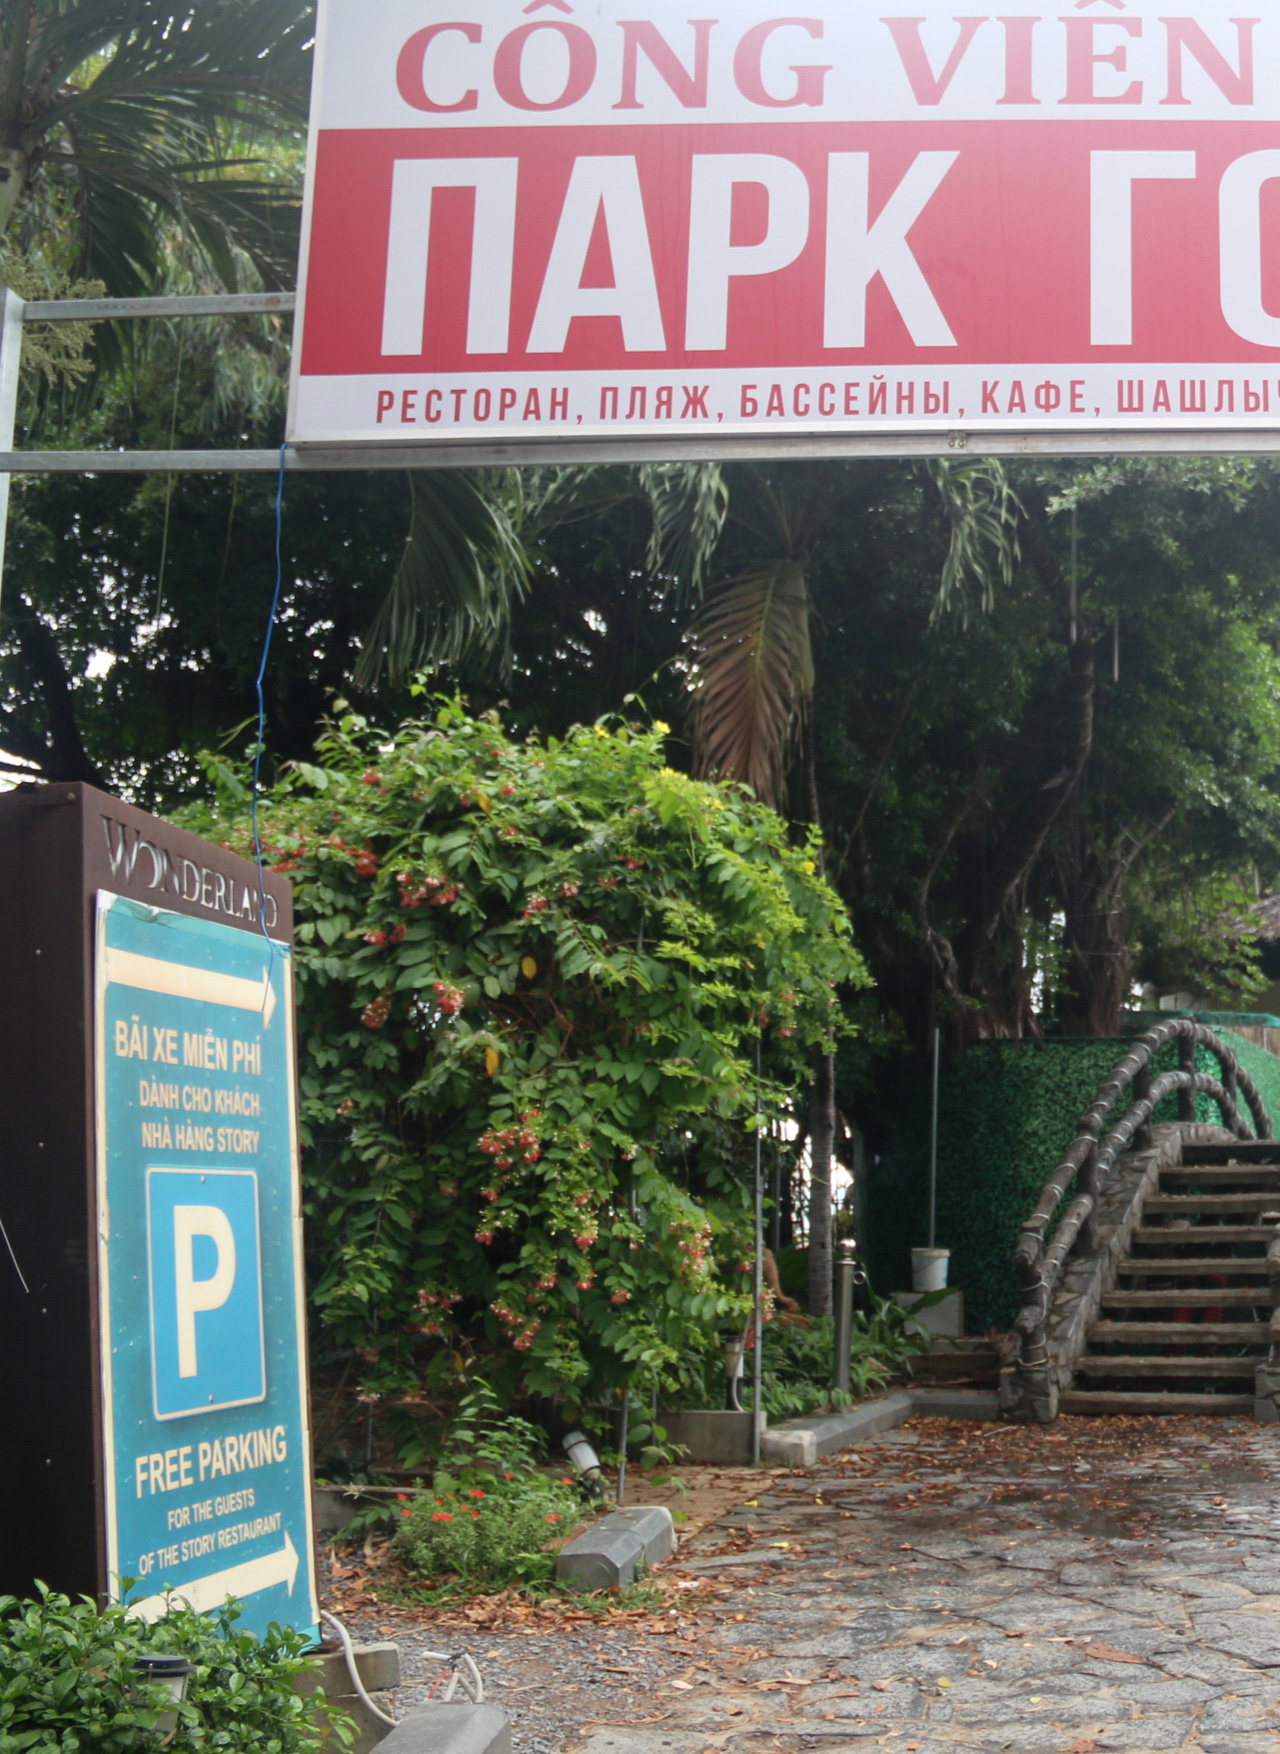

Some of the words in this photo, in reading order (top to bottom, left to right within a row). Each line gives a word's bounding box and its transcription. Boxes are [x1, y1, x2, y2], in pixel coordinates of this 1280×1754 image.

[395, 0, 833, 113] CÔNG
[879, 0, 1260, 106] VIÊN
[380, 150, 960, 355] ПАРК
[376, 387, 584, 424] РЕСТОРАН,
[600, 385, 725, 423] ПЛЯЖ,
[740, 375, 966, 420] БАССЕЙНЫ,
[981, 379, 1102, 417] КАФЕ,
[115, 1015, 148, 1060] BÃI
[153, 1027, 178, 1064] XE
[183, 1028, 228, 1071] MIỄN
[232, 1035, 261, 1075] PHÍ
[139, 1075, 179, 1109] DÀNH
[182, 1086, 212, 1113] CHO
[215, 1085, 260, 1117] KHÁCH
[142, 1116, 172, 1149] NHÀ
[175, 1119, 214, 1152] HÀNG
[217, 1128, 260, 1154] STORY
[173, 1205, 236, 1378] P
[135, 1446, 194, 1499] FREE
[198, 1425, 287, 1482] PARKING
[168, 1506, 190, 1531] FOR
[192, 1500, 213, 1523] THE
[215, 1488, 255, 1517] GUESTS
[139, 1552, 155, 1576] OF
[157, 1544, 180, 1569] THE
[181, 1533, 216, 1562] STORY
[217, 1512, 282, 1549] RESTAURANT
